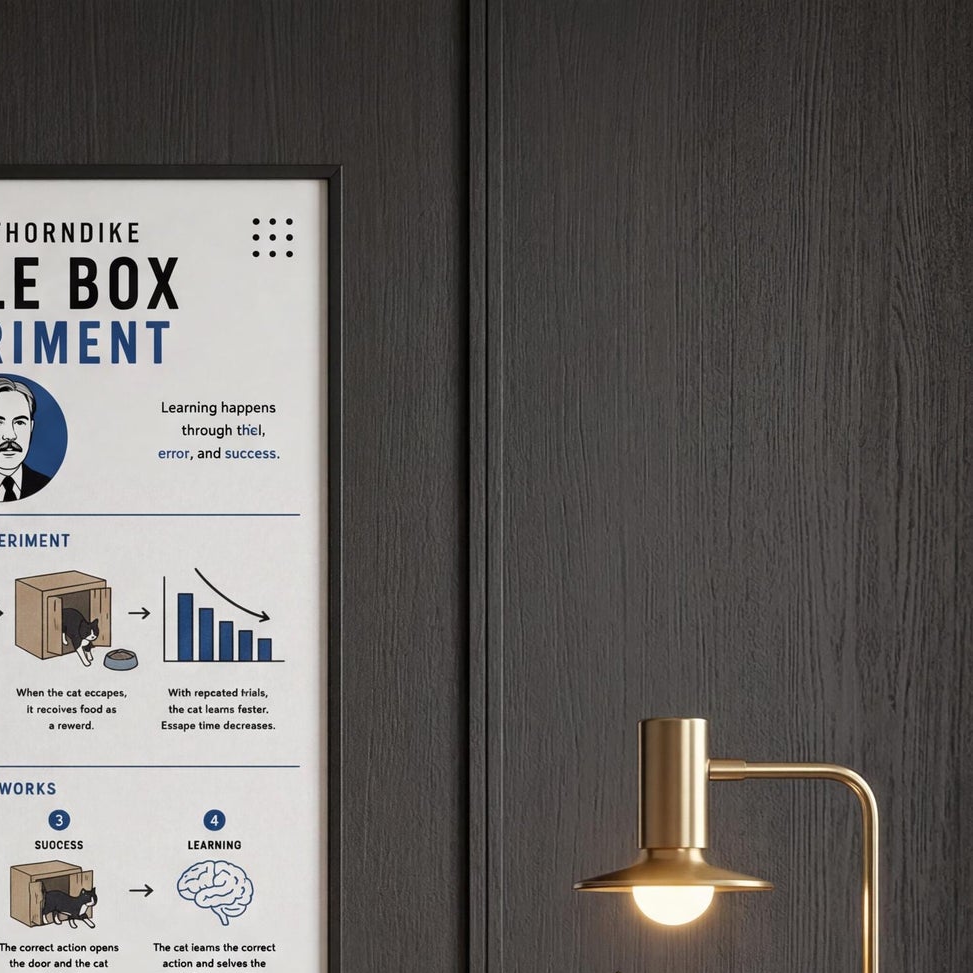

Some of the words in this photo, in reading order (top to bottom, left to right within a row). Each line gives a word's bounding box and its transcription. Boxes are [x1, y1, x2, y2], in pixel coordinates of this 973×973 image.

[69, 256, 179, 311] BOX
[161, 400, 218, 417] Learning
[221, 400, 277, 417] happens
[181, 423, 233, 440] through
[158, 450, 194, 461] error,
[197, 446, 222, 459] and
[224, 449, 280, 460] success.
[15, 687, 45, 698] When
[47, 687, 64, 698] the
[66, 688, 82, 698] cat
[167, 687, 192, 698] With
[26, 704, 34, 714] it
[79, 704, 103, 714] food
[105, 706, 117, 714] as
[168, 704, 185, 714] the
[186, 705, 203, 714] cat
[198, 720, 221, 730] time
[223, 720, 276, 730] decreases.
[55, 814, 64, 827] 3
[210, 814, 219, 827] 4
[187, 840, 242, 850] LEARNING
[19, 943, 55, 953] correct
[56, 943, 87, 953] action
[89, 944, 120, 955] opens
[152, 942, 171, 952] The
[222, 942, 239, 952] the
[240, 943, 276, 952] correct
[9, 958, 26, 968] the
[28, 958, 52, 968] door
[53, 958, 73, 968] and
[74, 958, 91, 968] the
[92, 959, 109, 968] cat
[162, 958, 193, 968] action
[195, 958, 215, 968] and
[250, 958, 267, 968] the
